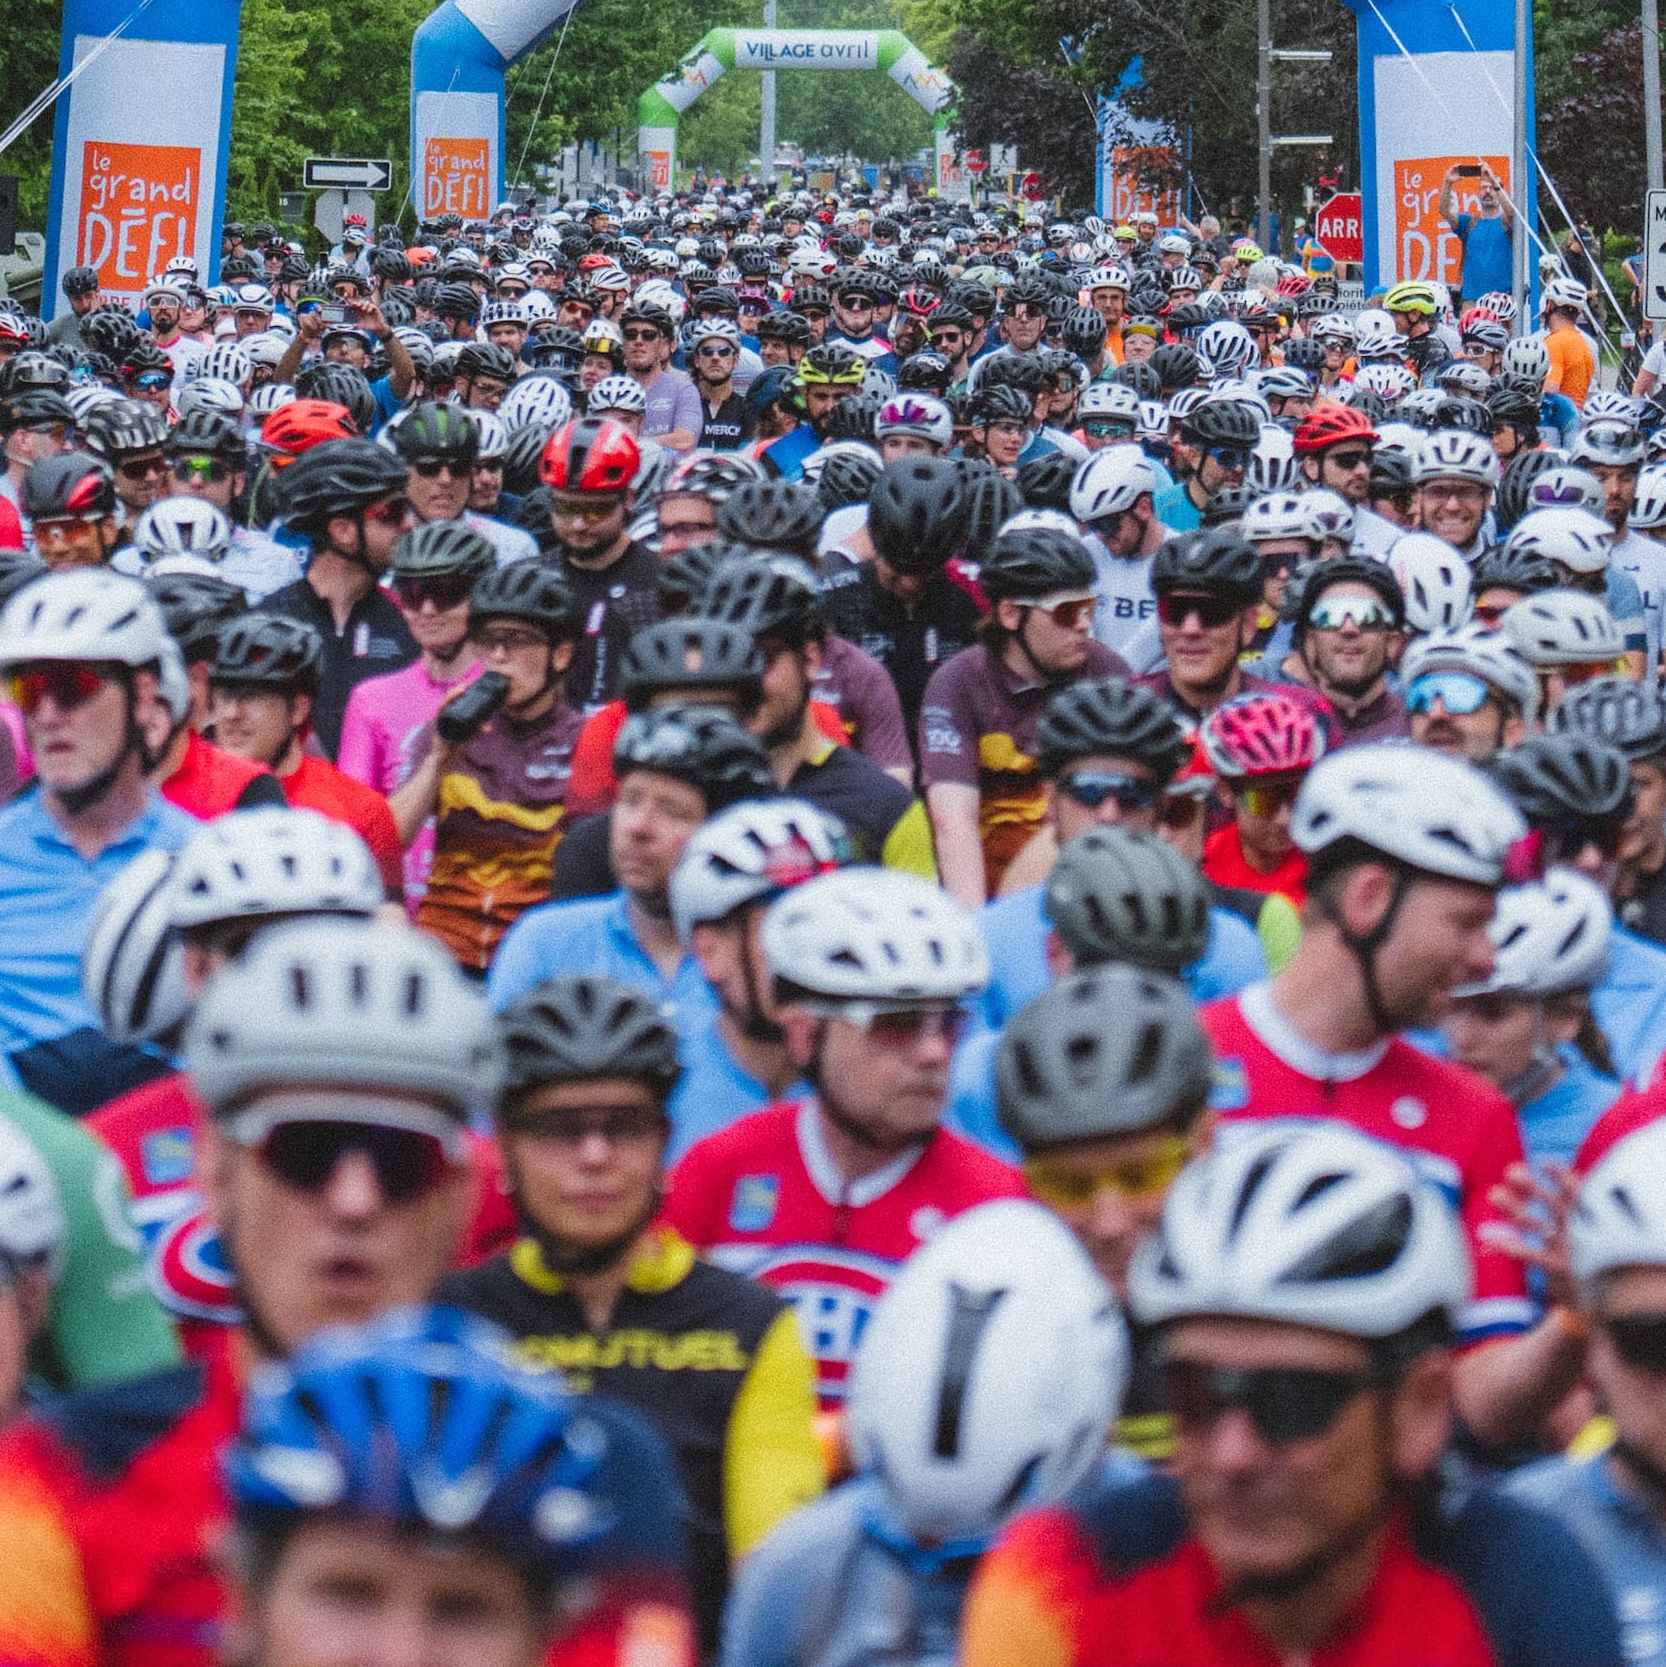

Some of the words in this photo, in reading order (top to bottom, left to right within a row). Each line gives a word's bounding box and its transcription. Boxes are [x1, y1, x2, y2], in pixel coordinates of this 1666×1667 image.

[746, 42, 815, 61] VILLAGE
[820, 40, 869, 58] avril
[93, 149, 111, 171] le
[428, 148, 485, 175] grand
[89, 167, 192, 210] grand
[1402, 168, 1423, 190] le
[1402, 179, 1483, 228] grn
[1320, 217, 1360, 239] ARR
[917, 356, 945, 371] POC
